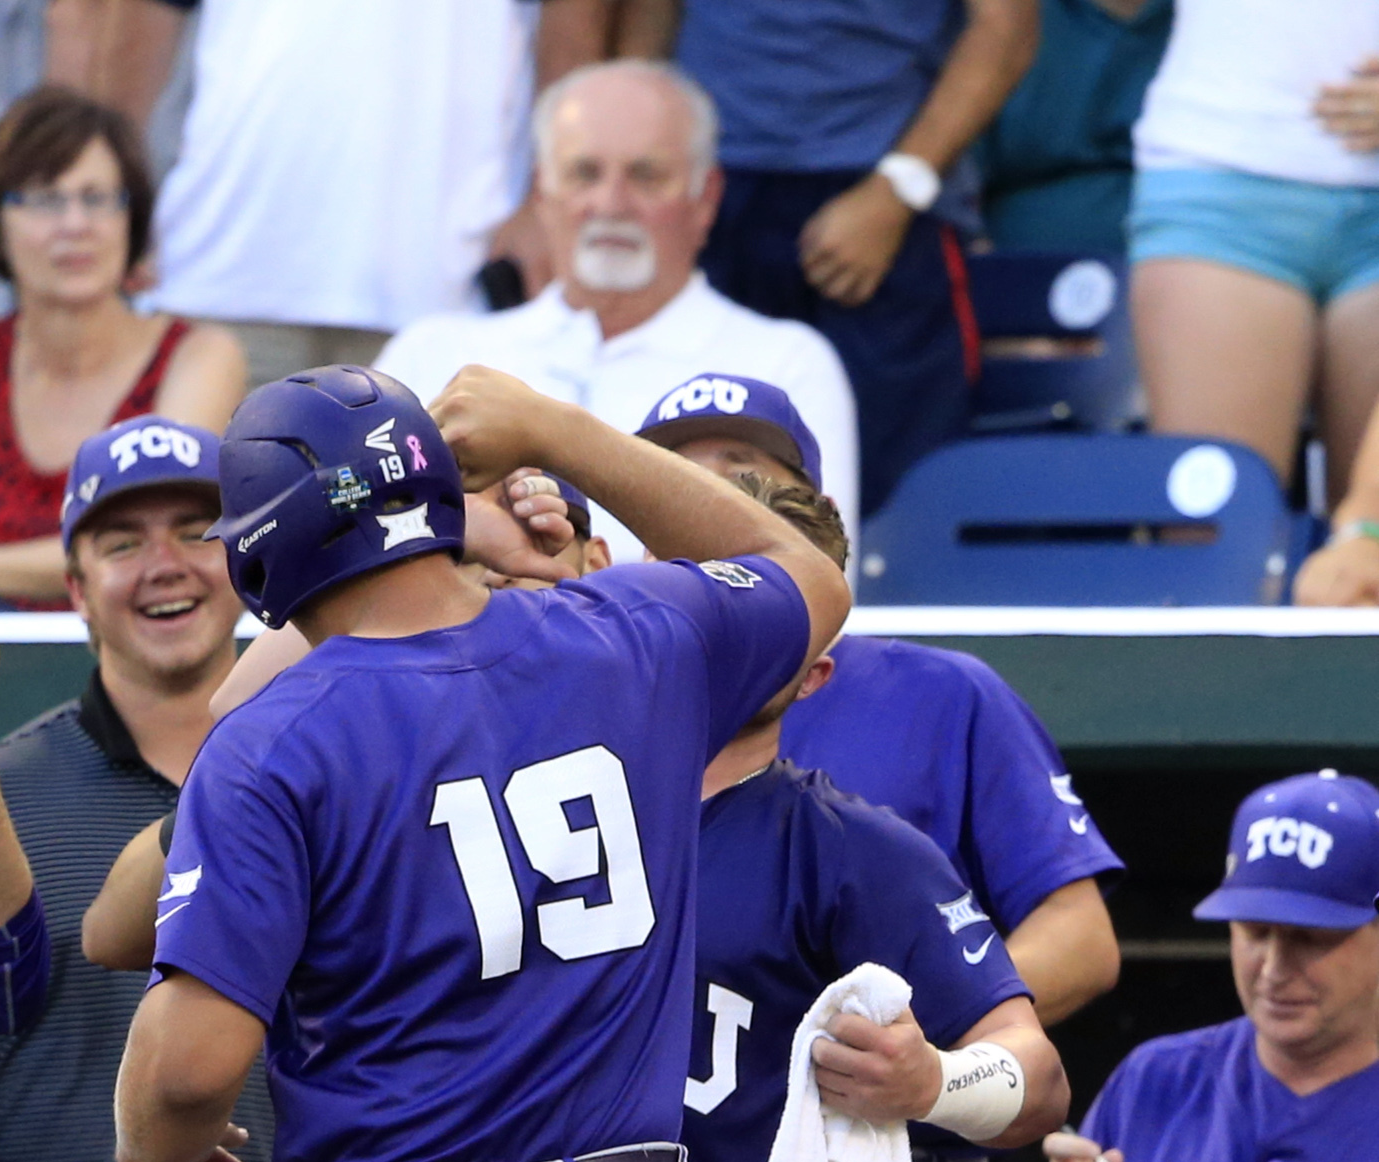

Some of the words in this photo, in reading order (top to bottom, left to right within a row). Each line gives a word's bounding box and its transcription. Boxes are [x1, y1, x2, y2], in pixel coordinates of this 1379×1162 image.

[109, 425, 201, 474] TCU
[378, 454, 405, 483] 19
[244, 519, 277, 549] EASTON
[428, 743, 657, 981] 19
[1246, 815, 1334, 869] TCU
